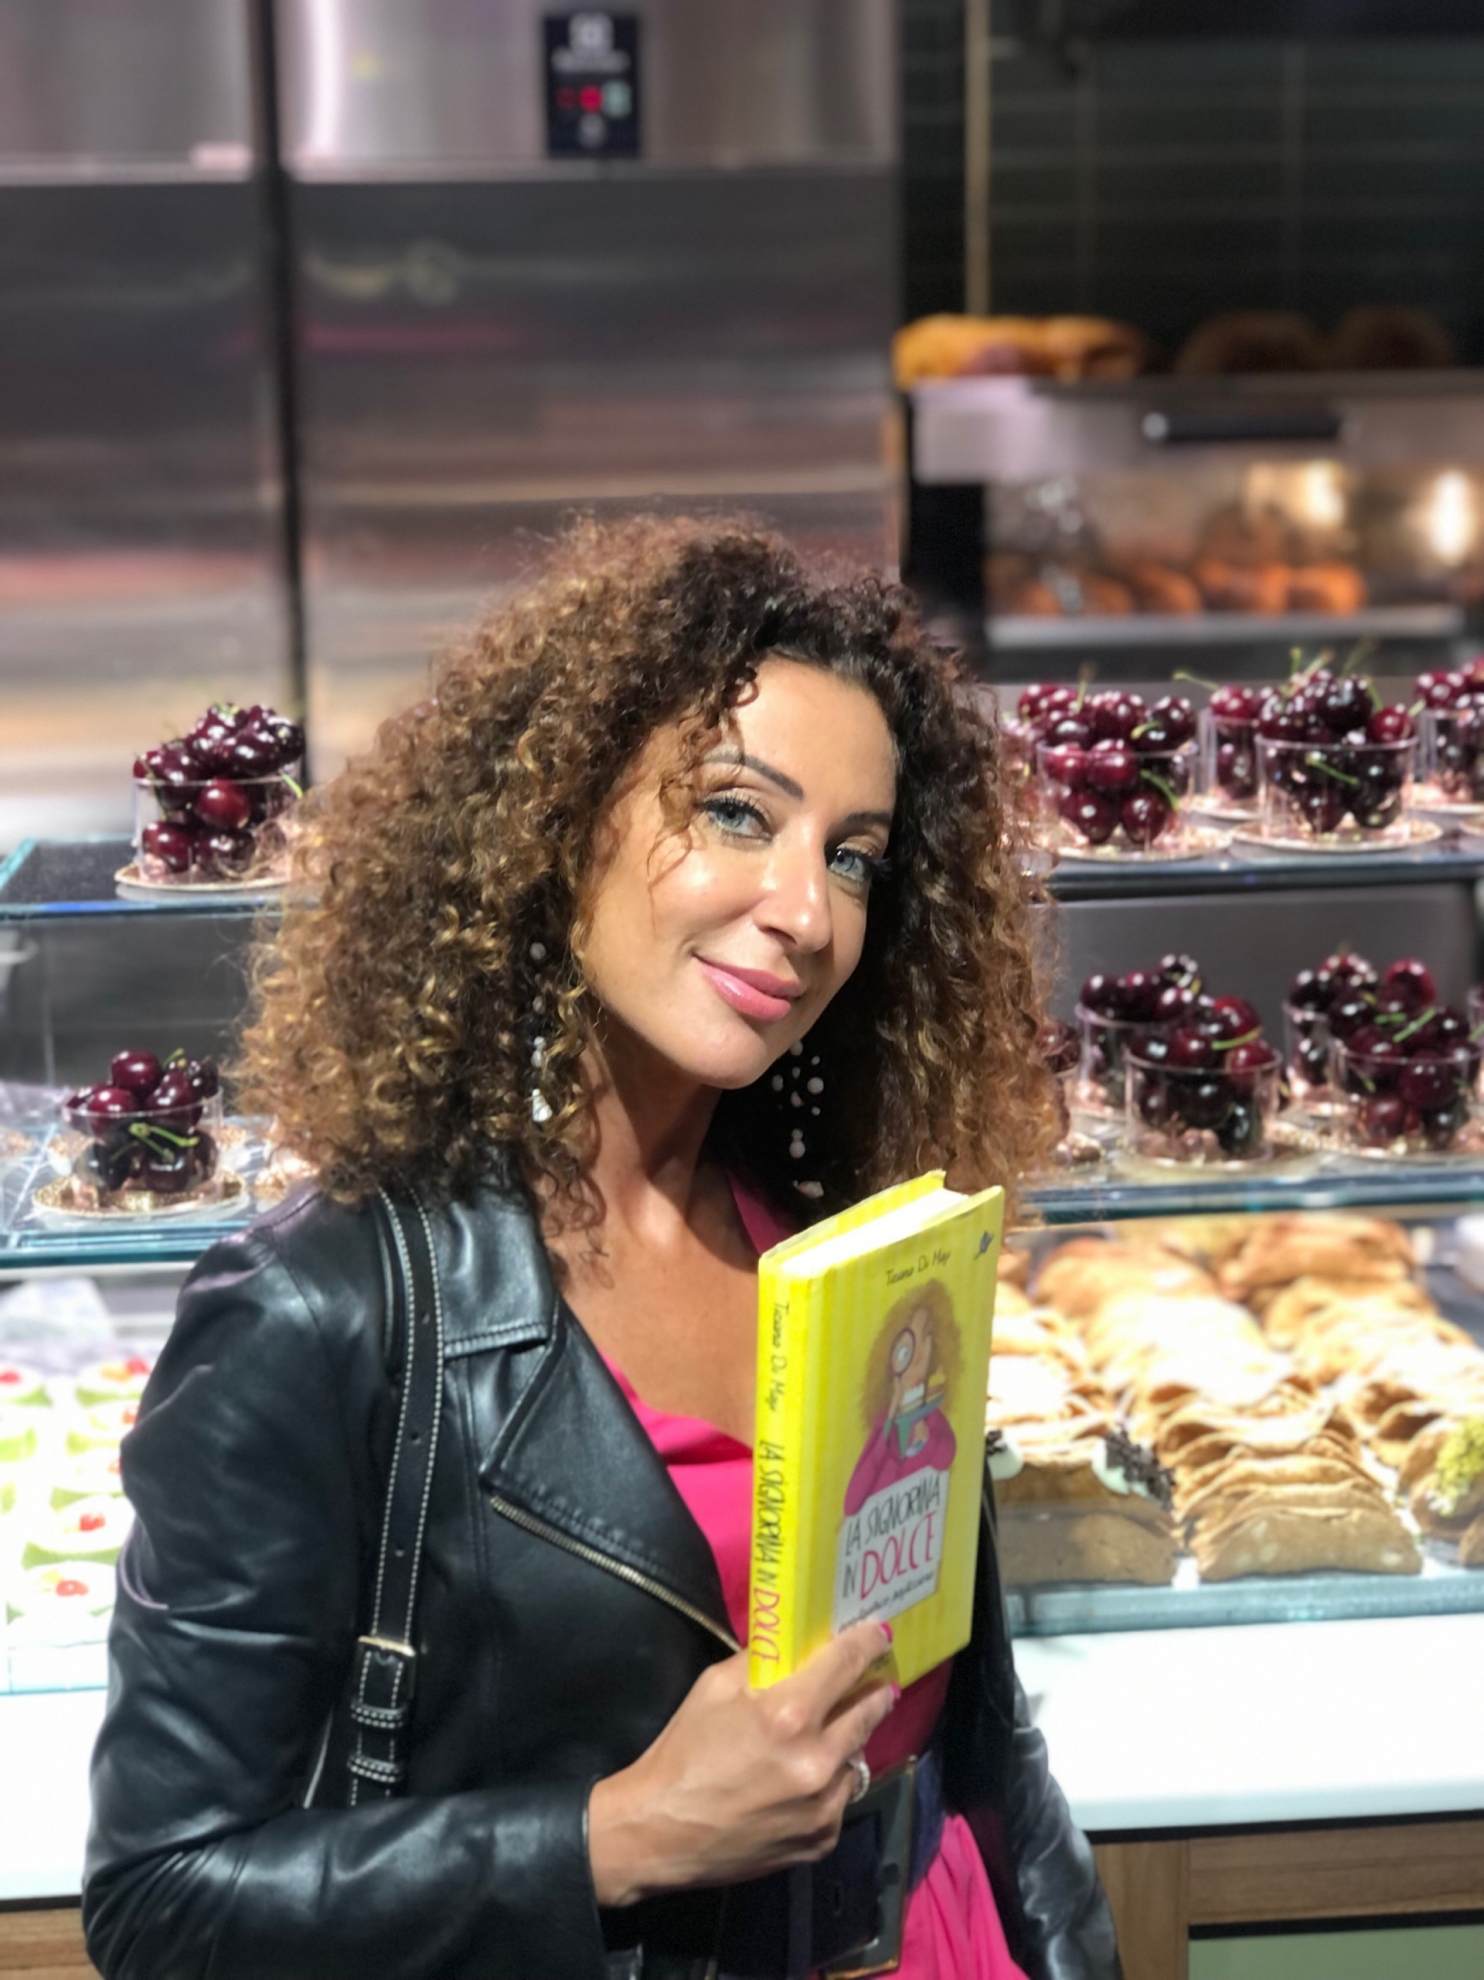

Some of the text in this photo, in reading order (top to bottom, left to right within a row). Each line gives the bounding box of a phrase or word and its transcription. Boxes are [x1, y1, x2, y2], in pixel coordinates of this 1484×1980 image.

[759, 1439, 785, 1461] LA
[757, 1465, 785, 1564] SIGNORINA
[841, 1510, 938, 1601] IN DOLCE
[845, 1474, 940, 1557] LA SIGNORINA
[752, 1587, 780, 1664] DOLCE
